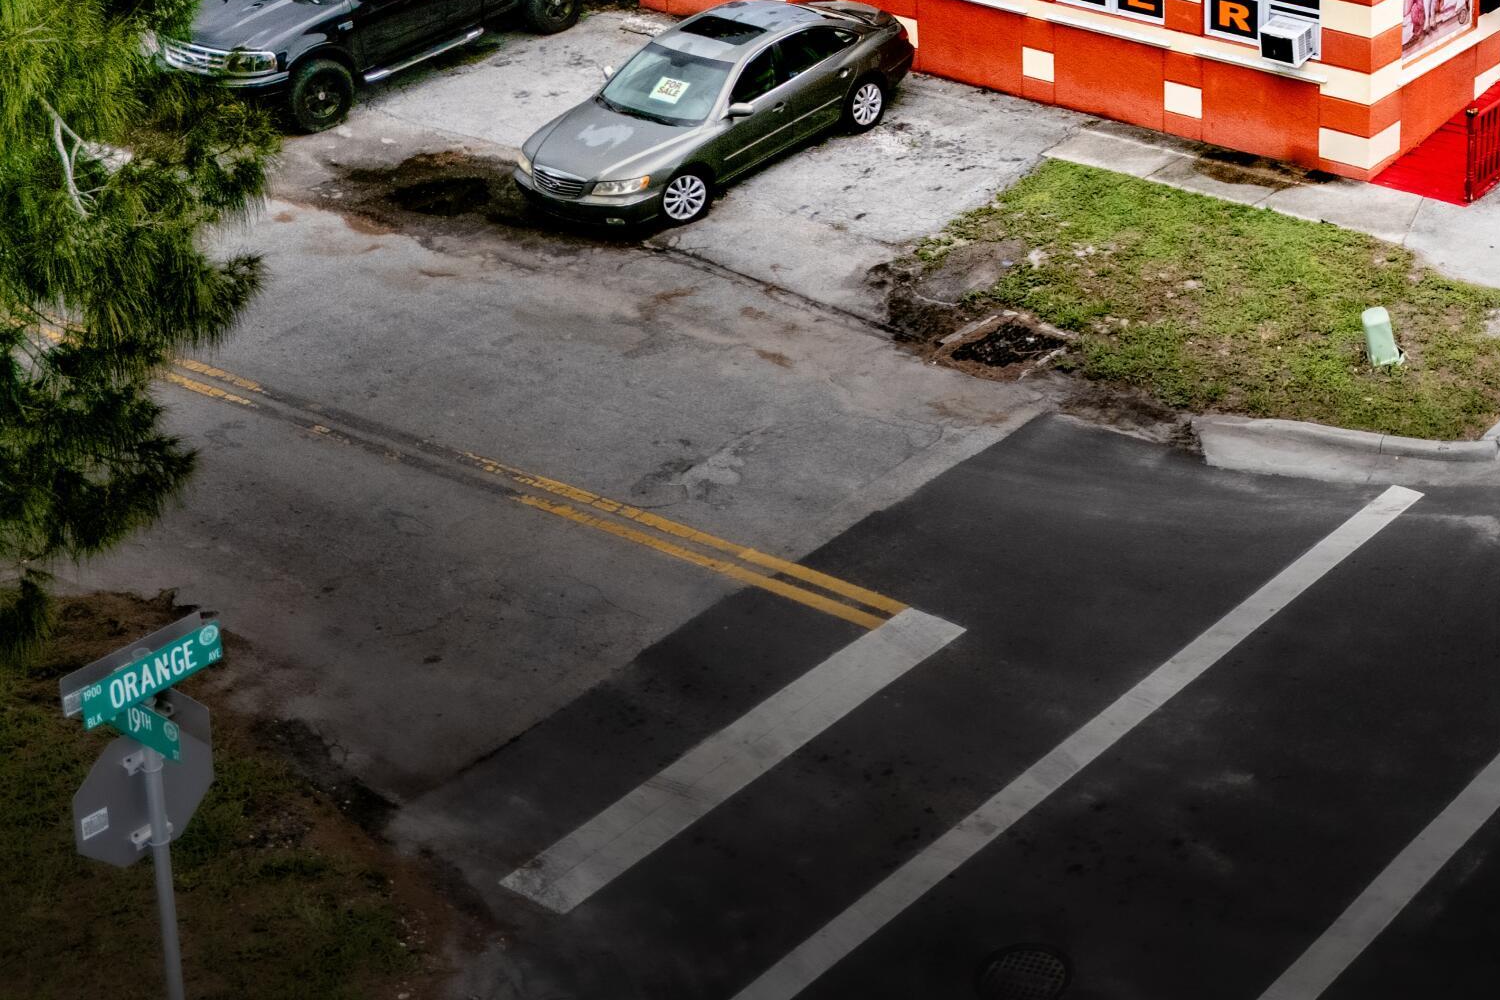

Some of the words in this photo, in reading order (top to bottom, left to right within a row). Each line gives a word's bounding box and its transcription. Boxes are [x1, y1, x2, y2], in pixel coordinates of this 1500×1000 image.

[657, 86, 680, 97] SALE
[665, 80, 682, 89] FOR
[109, 639, 197, 709] ORANGE
[208, 648, 221, 662] AVE
[83, 684, 102, 702] 1900
[87, 713, 103, 729] BLK
[127, 708, 152, 733] 19TH
